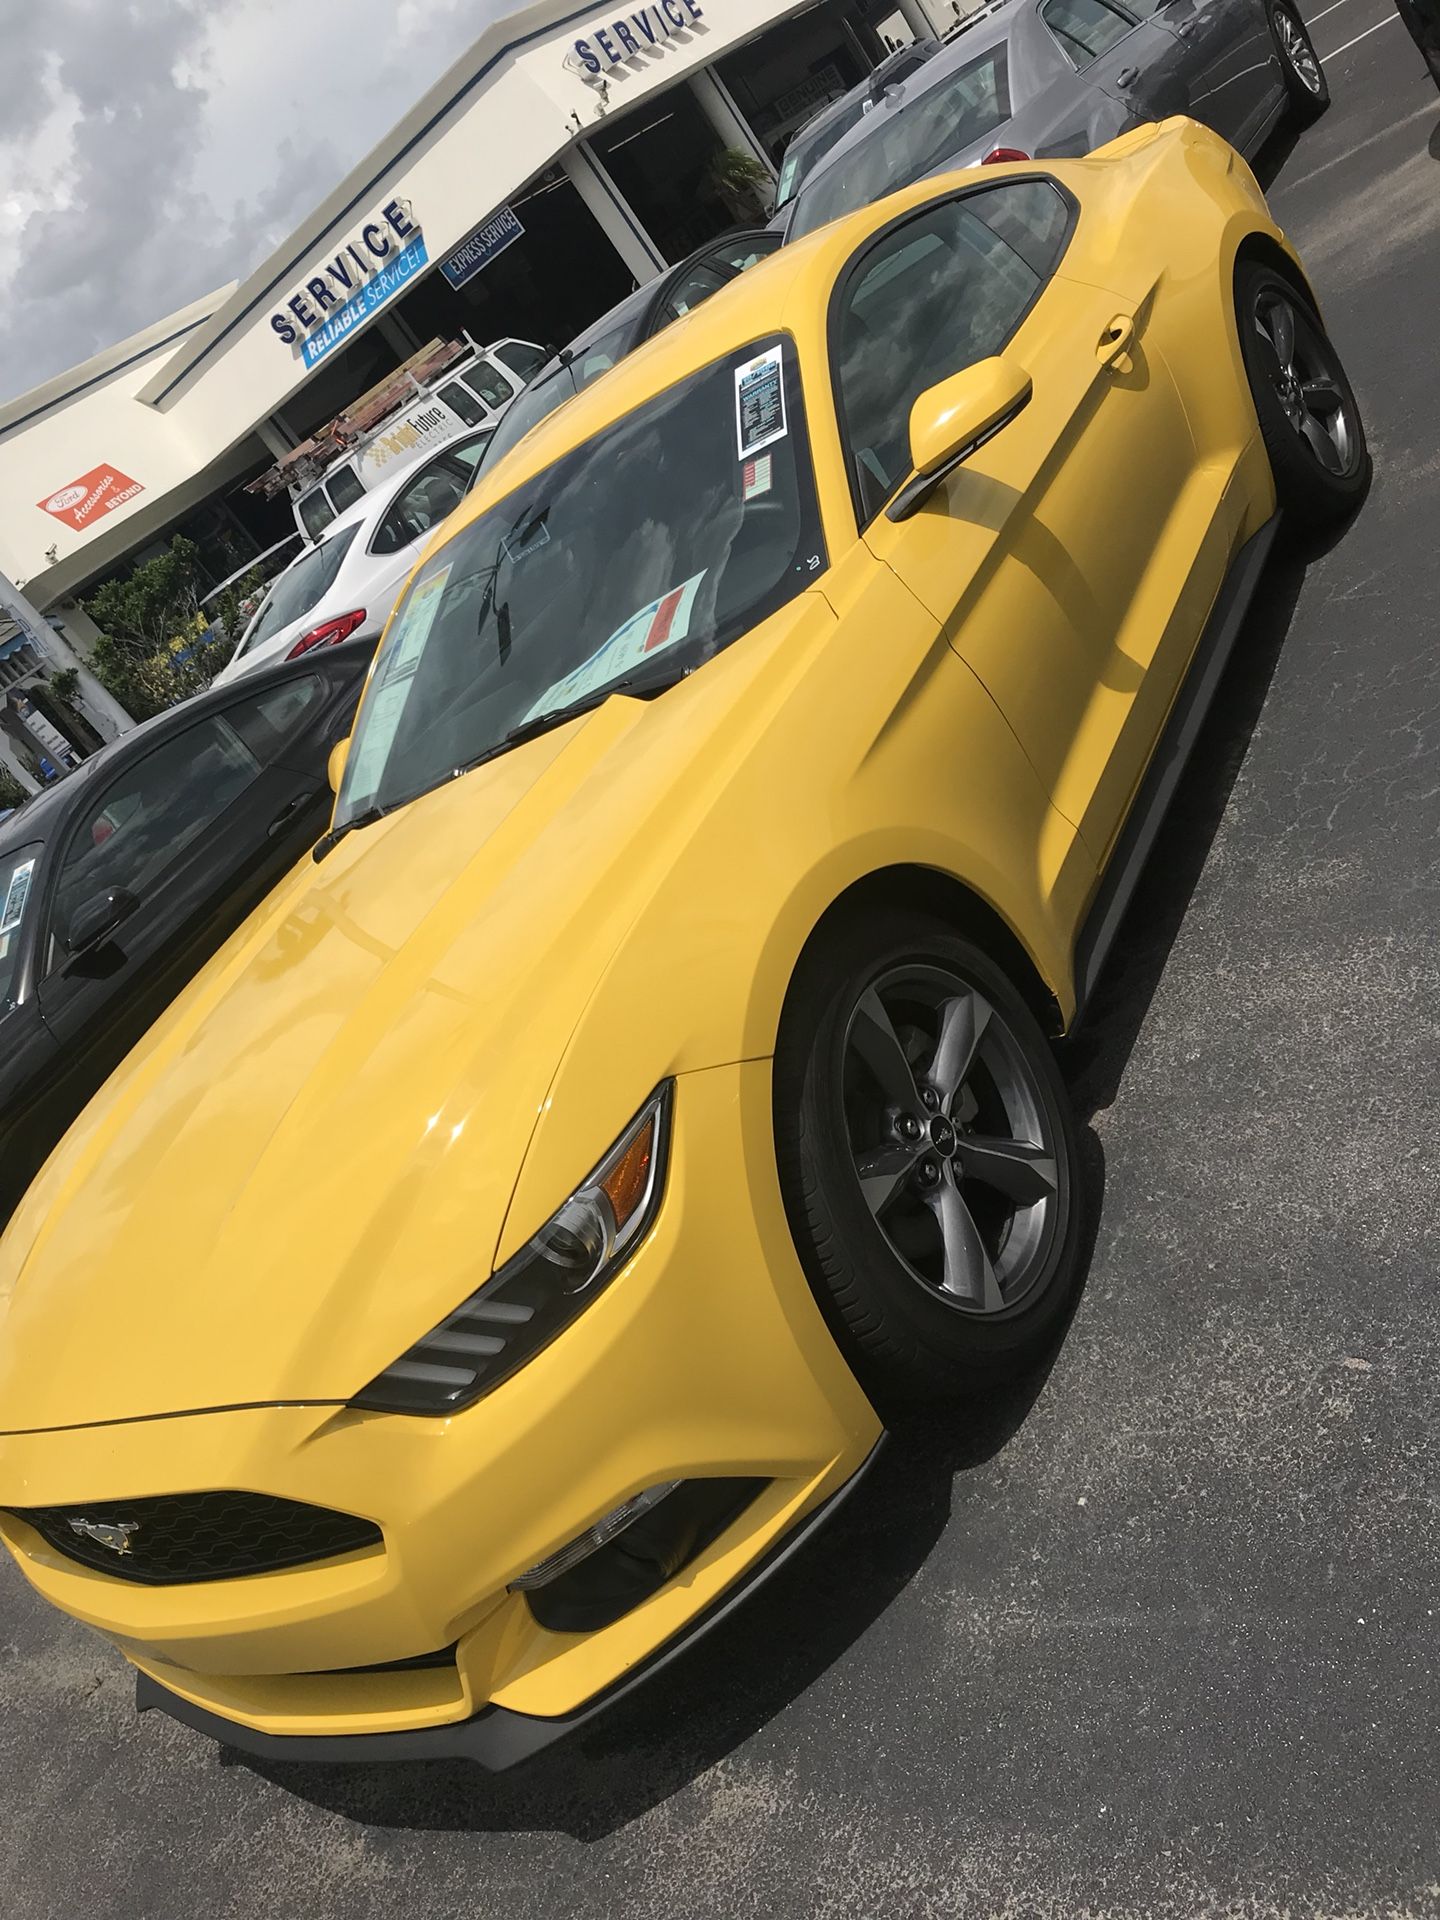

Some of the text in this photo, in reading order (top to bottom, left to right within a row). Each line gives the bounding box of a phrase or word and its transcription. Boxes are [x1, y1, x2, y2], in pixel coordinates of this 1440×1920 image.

[574, 0, 704, 74] SERVICE
[777, 66, 838, 114] GENUINE
[448, 210, 517, 275] EXPRESS SERVICE
[271, 200, 414, 345] SERVICE
[307, 245, 421, 360] RELIABLE SERVICE!
[742, 379, 778, 402] WARRANTY
[416, 418, 454, 449] ELECTRIC
[54, 490, 80, 508] Ford
[73, 475, 114, 523] Accessories
[104, 483, 142, 510] BEYOND
